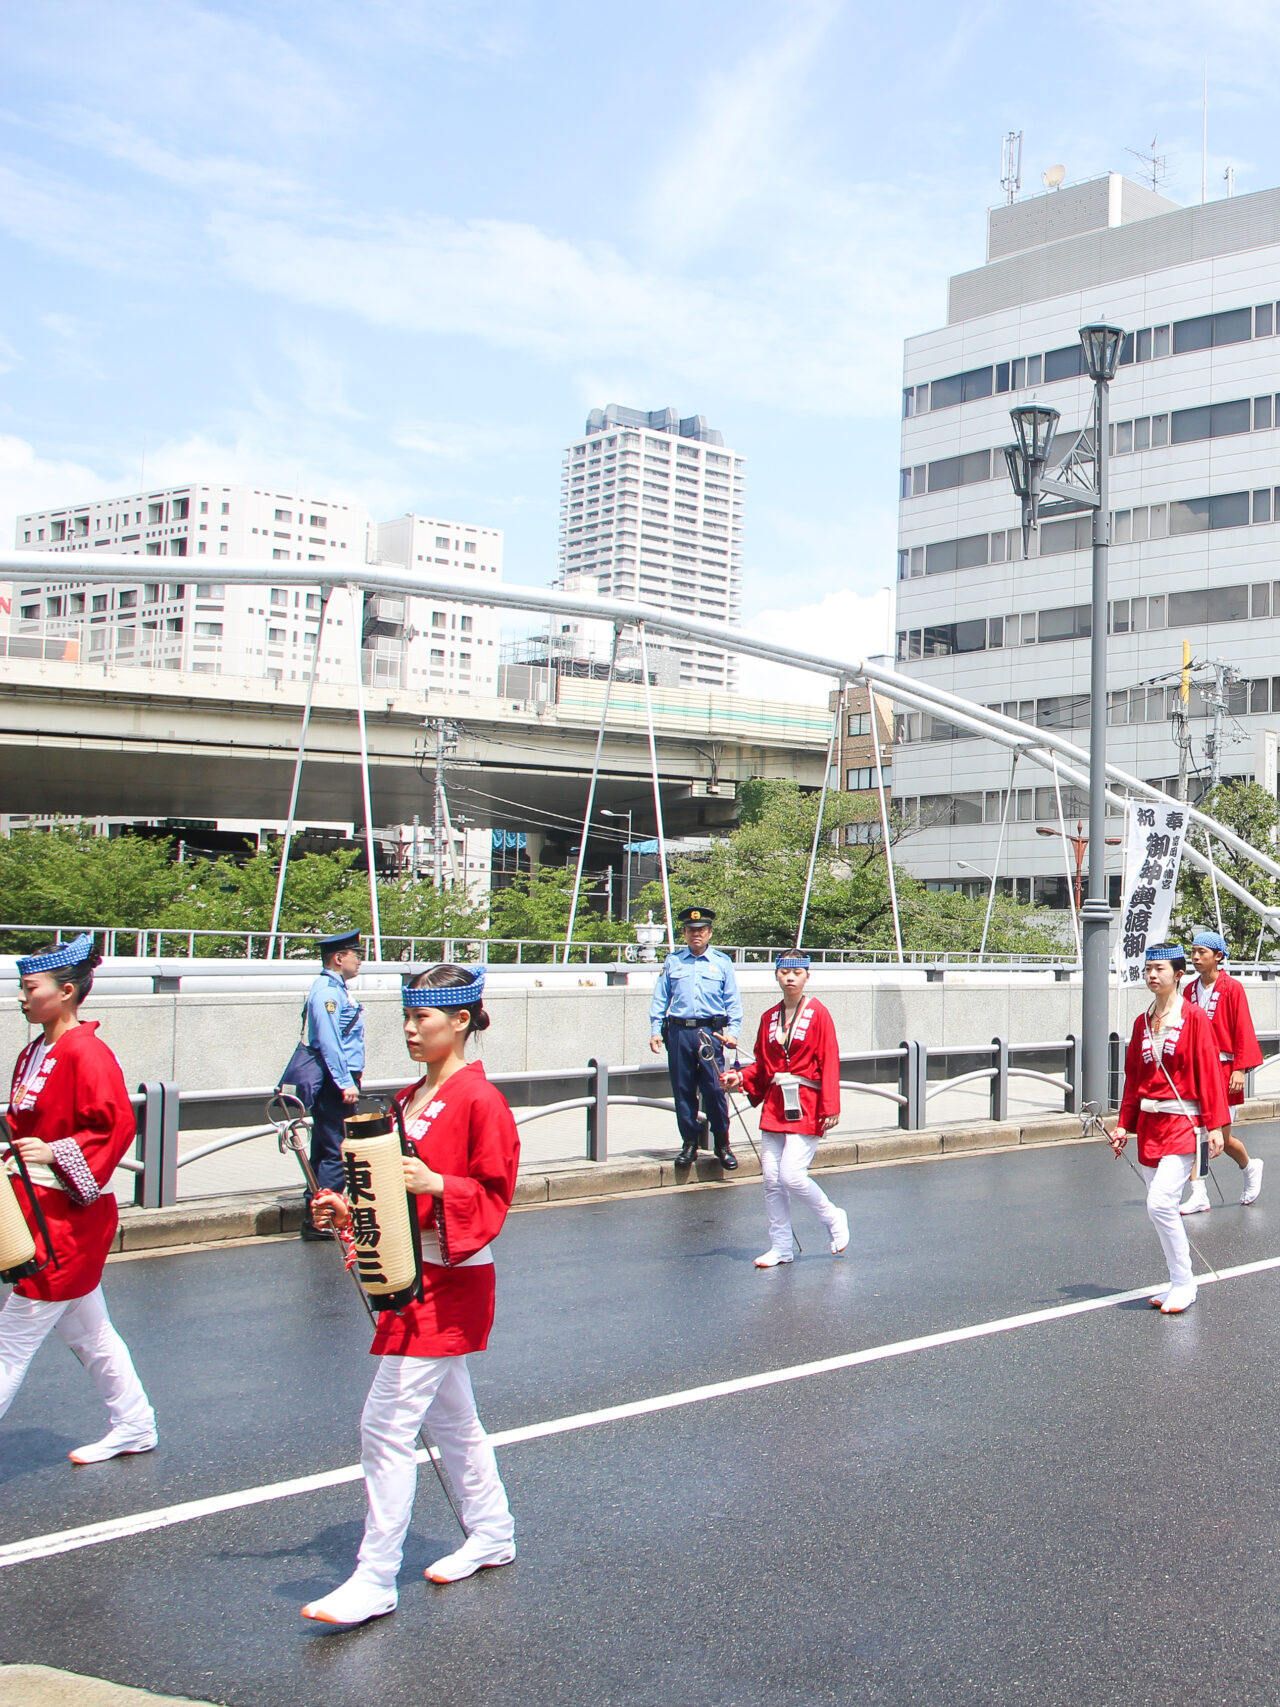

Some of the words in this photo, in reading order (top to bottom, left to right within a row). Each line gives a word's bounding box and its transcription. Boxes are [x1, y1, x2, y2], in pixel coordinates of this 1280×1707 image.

[1123, 832, 1170, 959] 御神輿渡御
[344, 1152, 388, 1284] 東陽三
